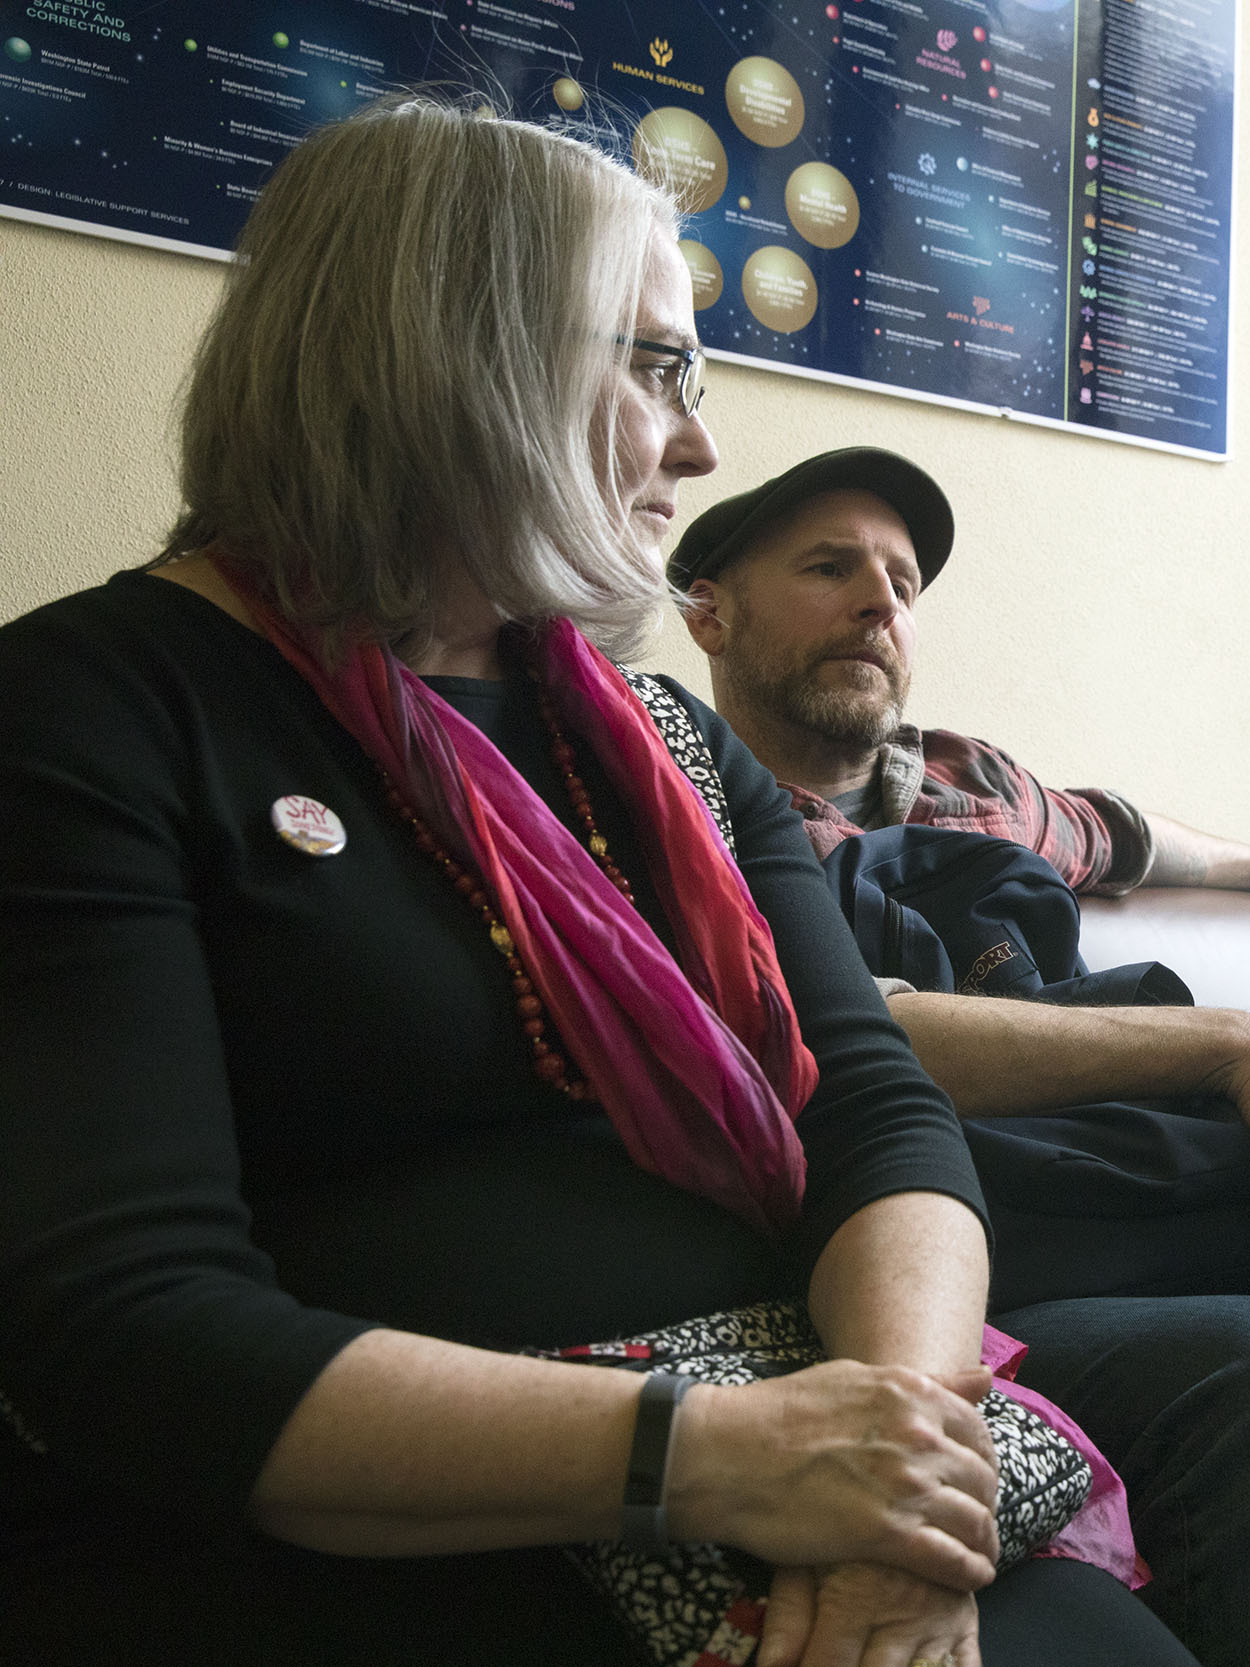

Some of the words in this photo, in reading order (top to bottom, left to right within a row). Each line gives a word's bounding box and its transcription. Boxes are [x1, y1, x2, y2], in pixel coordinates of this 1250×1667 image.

[26, 7, 131, 42] CORRECTIONS
[33, 0, 89, 19] SAFETY
[93, 13, 125, 28] AND
[41, 49, 76, 64] Washington
[77, 58, 92, 68] State
[92, 62, 110, 72] Patrol
[915, 56, 967, 80] RESOURCES
[921, 48, 961, 68] NATURAL
[22, 77, 63, 93] Investigations
[64, 87, 86, 99] Council
[612, 62, 654, 81] HUMAN
[655, 73, 705, 95] SERVICES
[164, 136, 187, 148] Minority
[694, 154, 716, 170] Care
[888, 172, 928, 190] INTERNAL
[931, 184, 971, 202] SERVICES
[893, 182, 906, 193] TO
[906, 186, 965, 208] GOVERNMENT
[55, 191, 107, 208] LEGISLATIVE
[109, 202, 148, 216] SUPPORT
[150, 210, 190, 225] SERVICES
[946, 311, 969, 323] ARTS
[979, 318, 1014, 334] CULTURE
[284, 795, 328, 825] SAY
